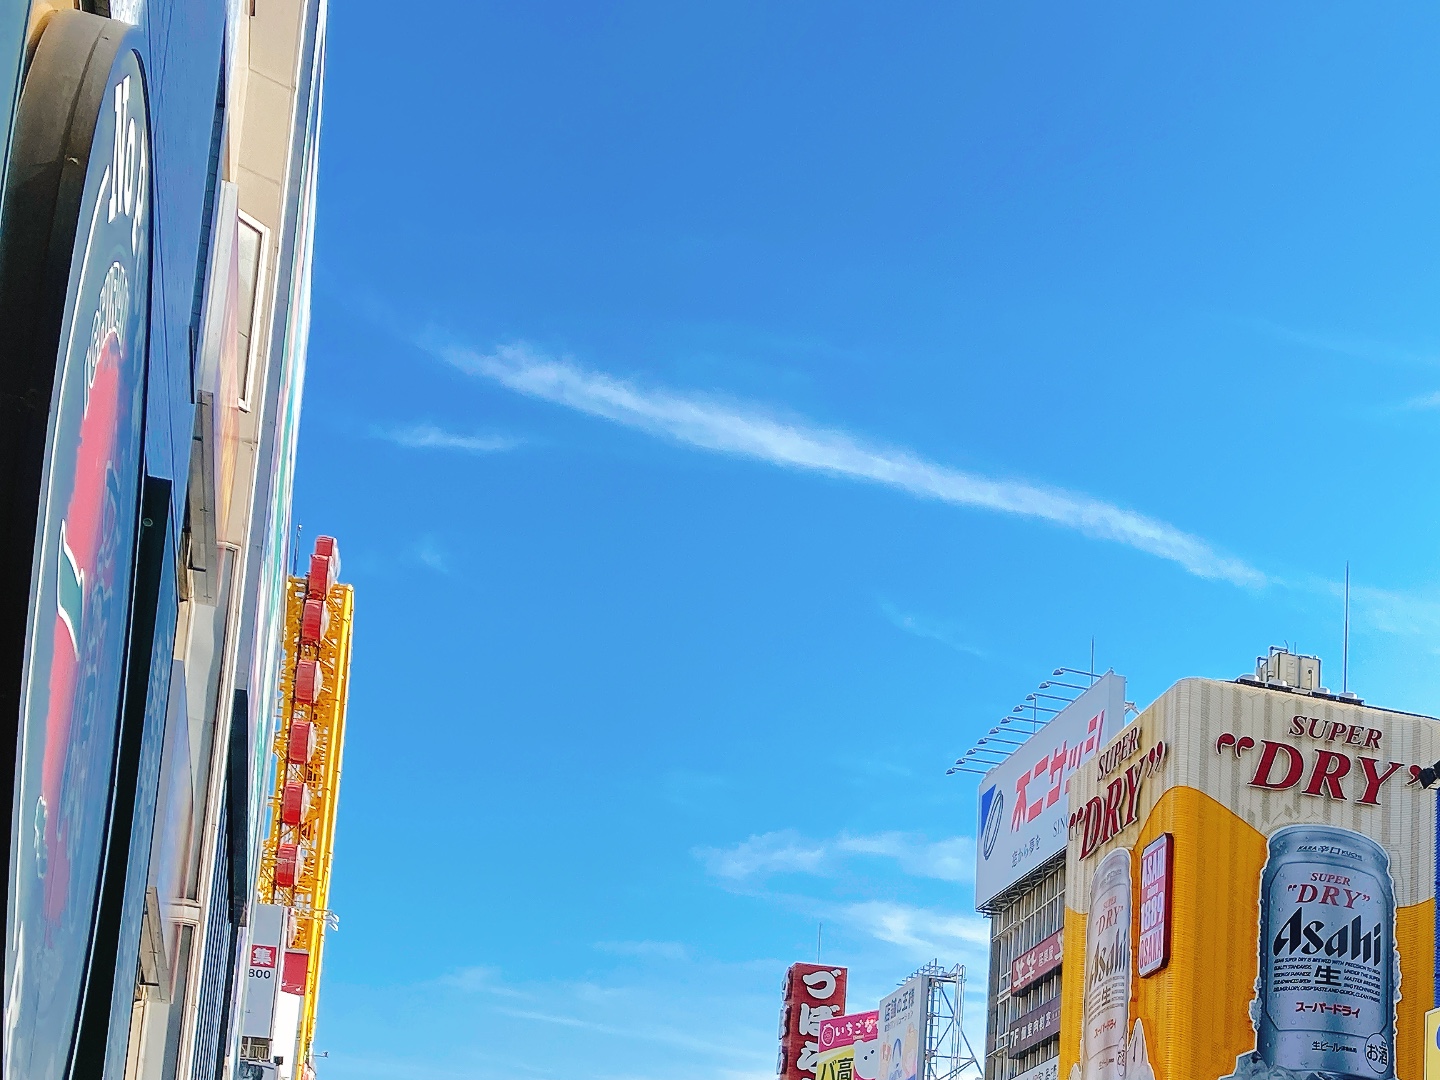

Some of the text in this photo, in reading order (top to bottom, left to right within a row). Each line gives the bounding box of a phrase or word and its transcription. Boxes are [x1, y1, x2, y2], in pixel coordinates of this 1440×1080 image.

[1288, 714, 1383, 750] SUPER
[1097, 726, 1141, 782] SUPER
[1310, 872, 1351, 886] SUPER
[1272, 906, 1382, 966] Asahi
[1314, 965, 1342, 986] 生
[1296, 1001, 1361, 1018] スーパードライ
